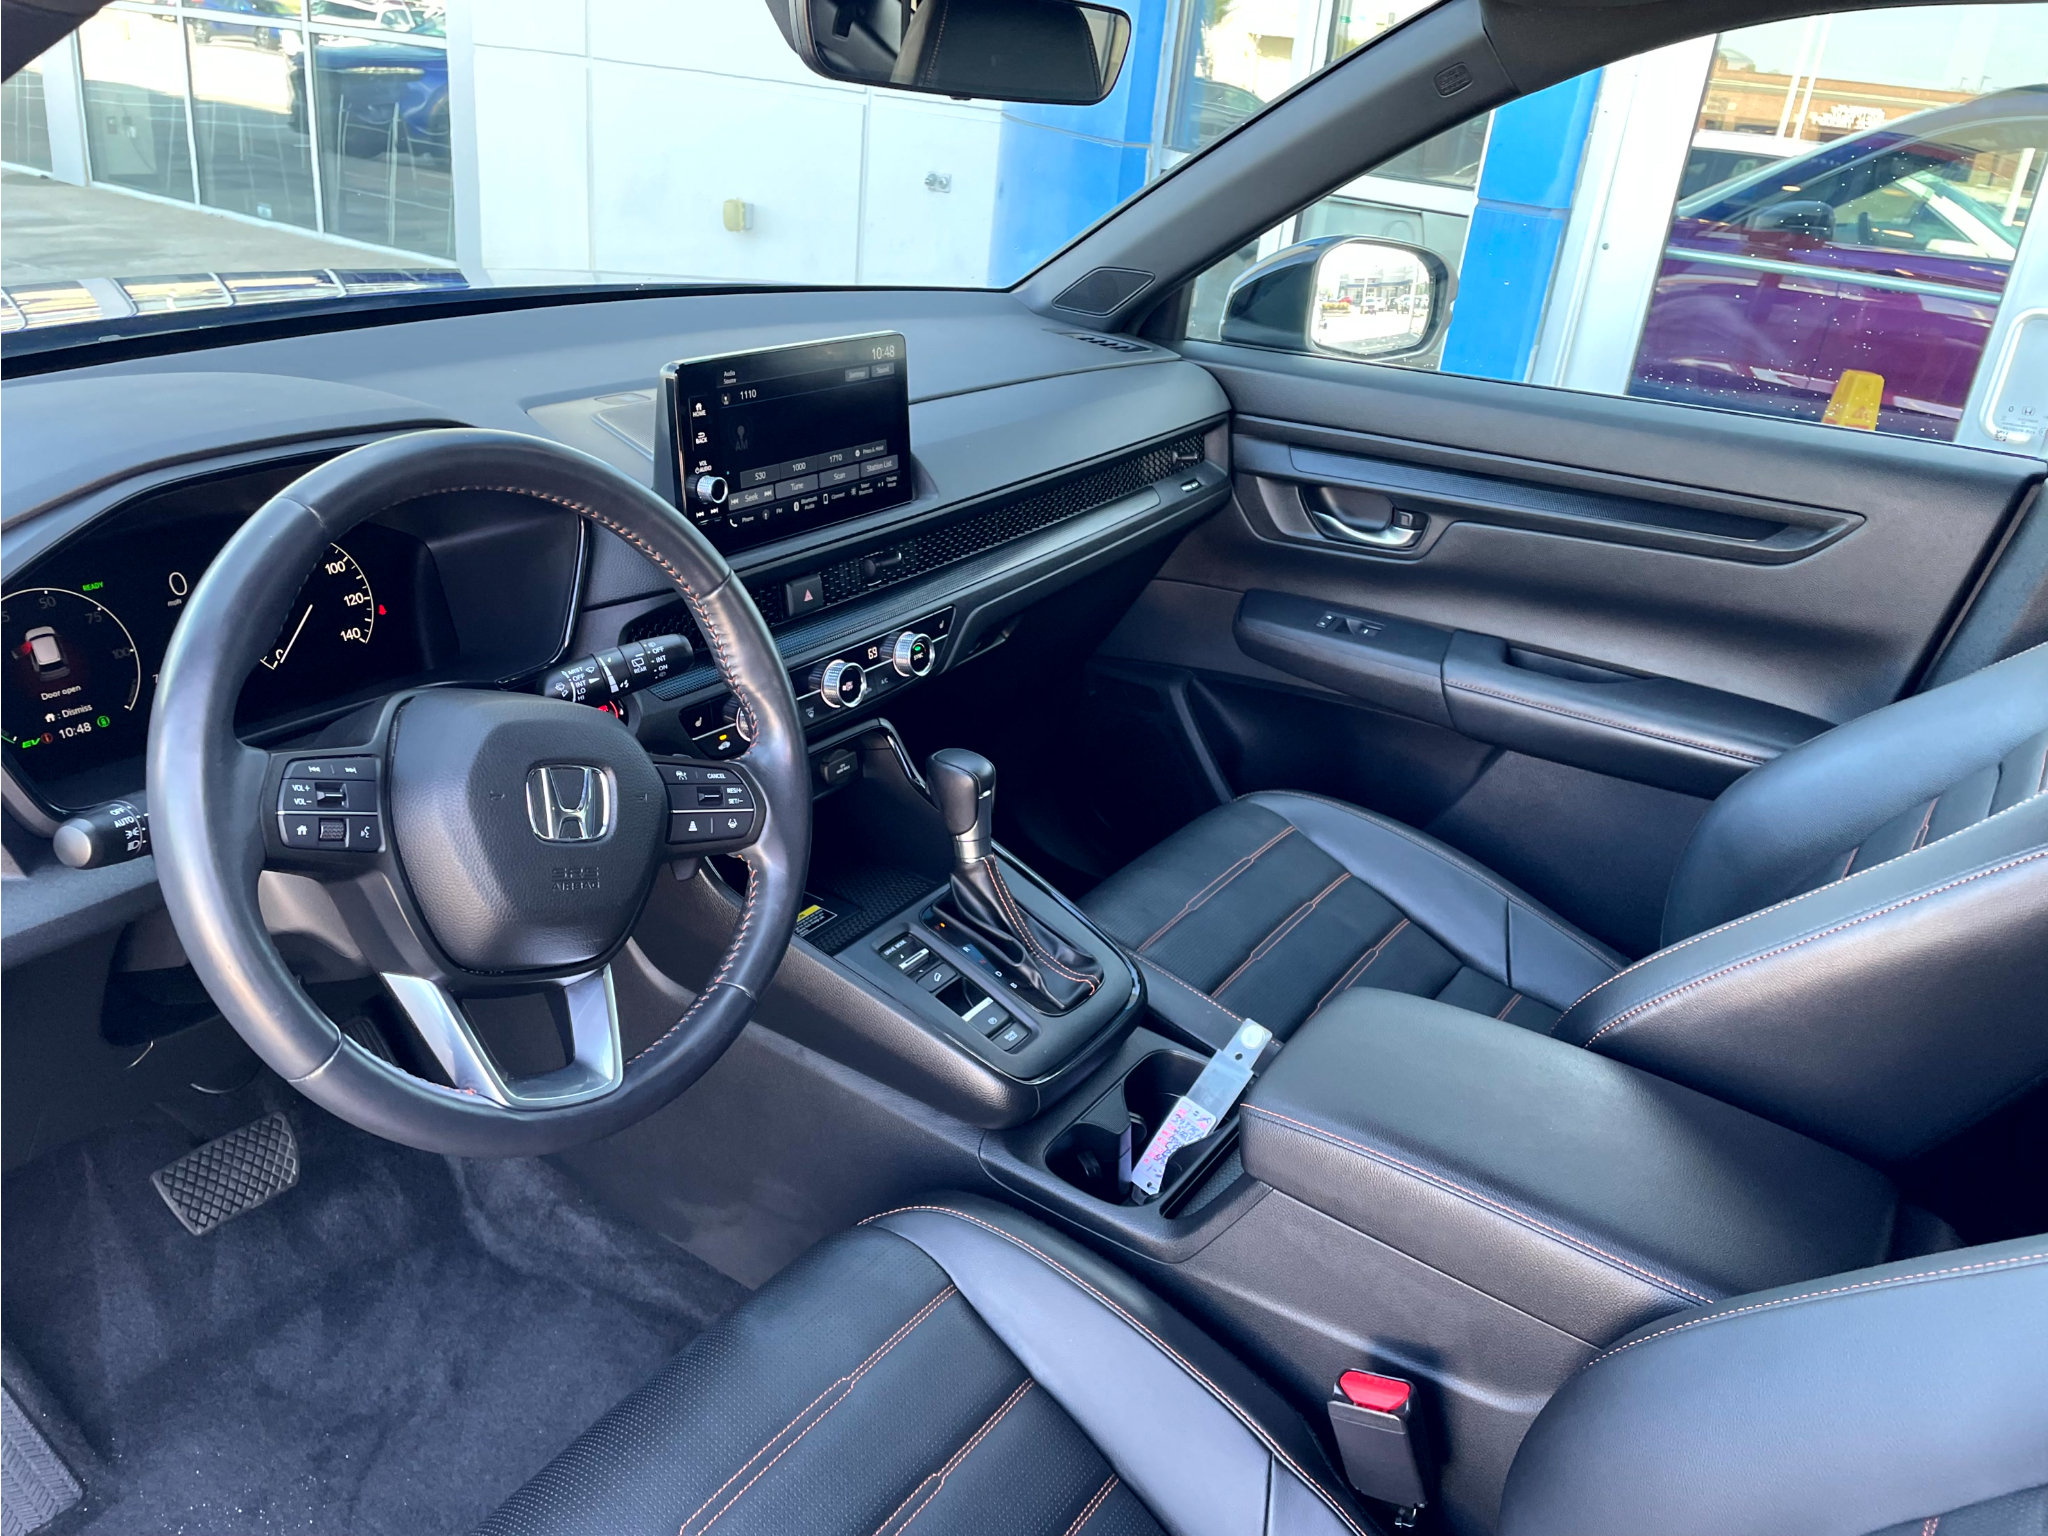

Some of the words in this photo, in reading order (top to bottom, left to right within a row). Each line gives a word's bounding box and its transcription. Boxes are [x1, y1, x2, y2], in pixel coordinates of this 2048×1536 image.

[872, 344, 895, 360] 10:48
[740, 389, 757, 400] 1110
[692, 410, 706, 418] HOME
[829, 454, 842, 463] 1710
[792, 462, 806, 472] 1000
[833, 472, 846, 480] Scan
[790, 482, 804, 491] Tune
[744, 494, 758, 502] Seek
[324, 560, 346, 575] 100
[82, 581, 104, 592] READY
[168, 572, 188, 596] 0
[39, 596, 56, 609] 50
[344, 592, 364, 606] 120
[84, 611, 102, 624] 75
[340, 627, 361, 642] 140
[652, 646, 664, 654] OFF
[867, 646, 878, 660] 69
[656, 654, 666, 663] INT
[914, 652, 924, 660] SYNC
[634, 666, 647, 674] REAR
[572, 673, 584, 682] OFF
[576, 680, 586, 688] INT
[40, 690, 60, 700] Door
[62, 685, 82, 695] open
[62, 704, 92, 718] Dismiss
[22, 738, 40, 748] EV
[59, 722, 92, 739] 10:48
[706, 772, 726, 780] CANCEL
[110, 806, 124, 816] OFF
[114, 816, 134, 828] AUTO
[552, 866, 600, 880] SRS
[552, 881, 600, 890] AIRBAG
